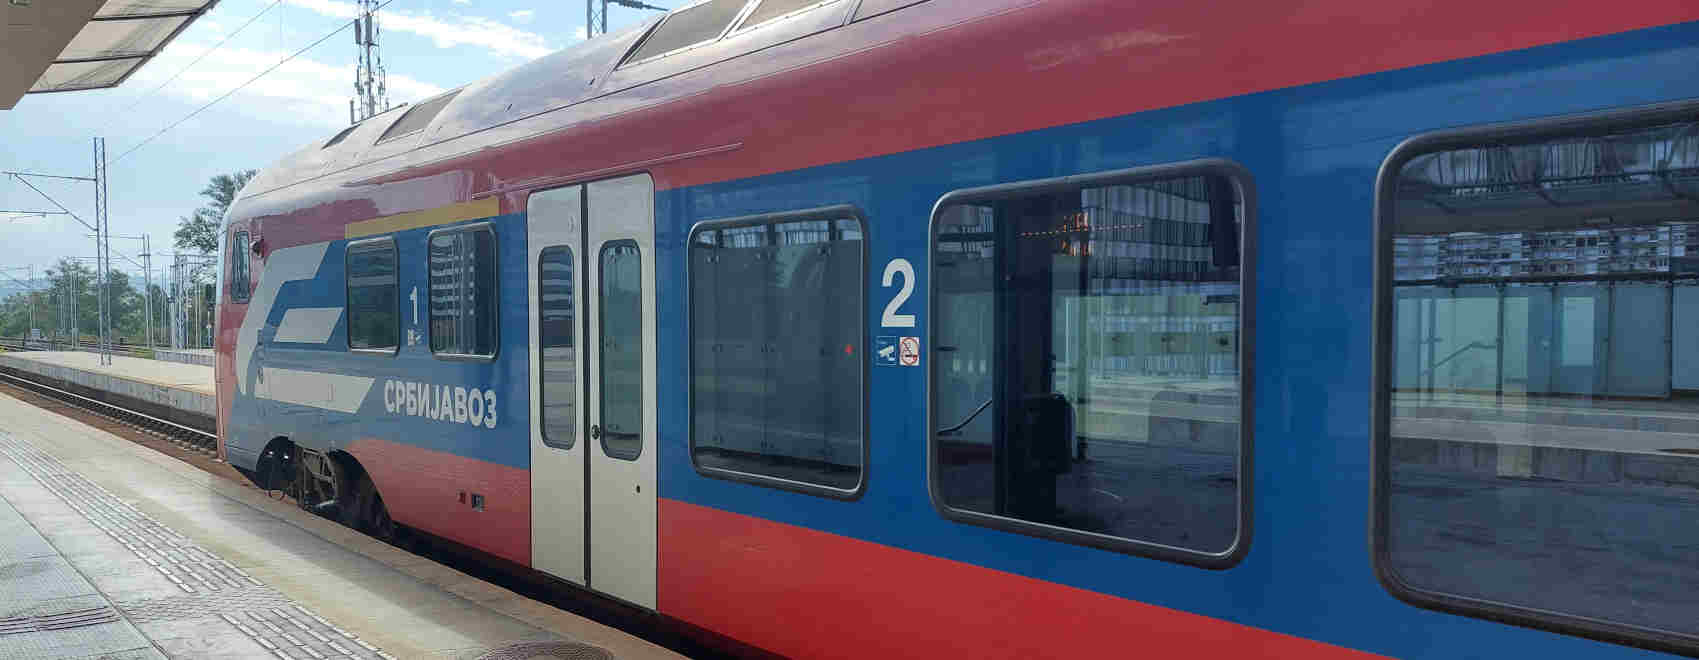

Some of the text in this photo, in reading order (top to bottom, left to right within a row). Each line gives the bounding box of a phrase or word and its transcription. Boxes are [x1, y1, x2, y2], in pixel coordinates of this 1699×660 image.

[409, 286, 419, 325] 1
[881, 258, 915, 328] 2
[384, 379, 497, 429] СРБИЈАВОЗ
